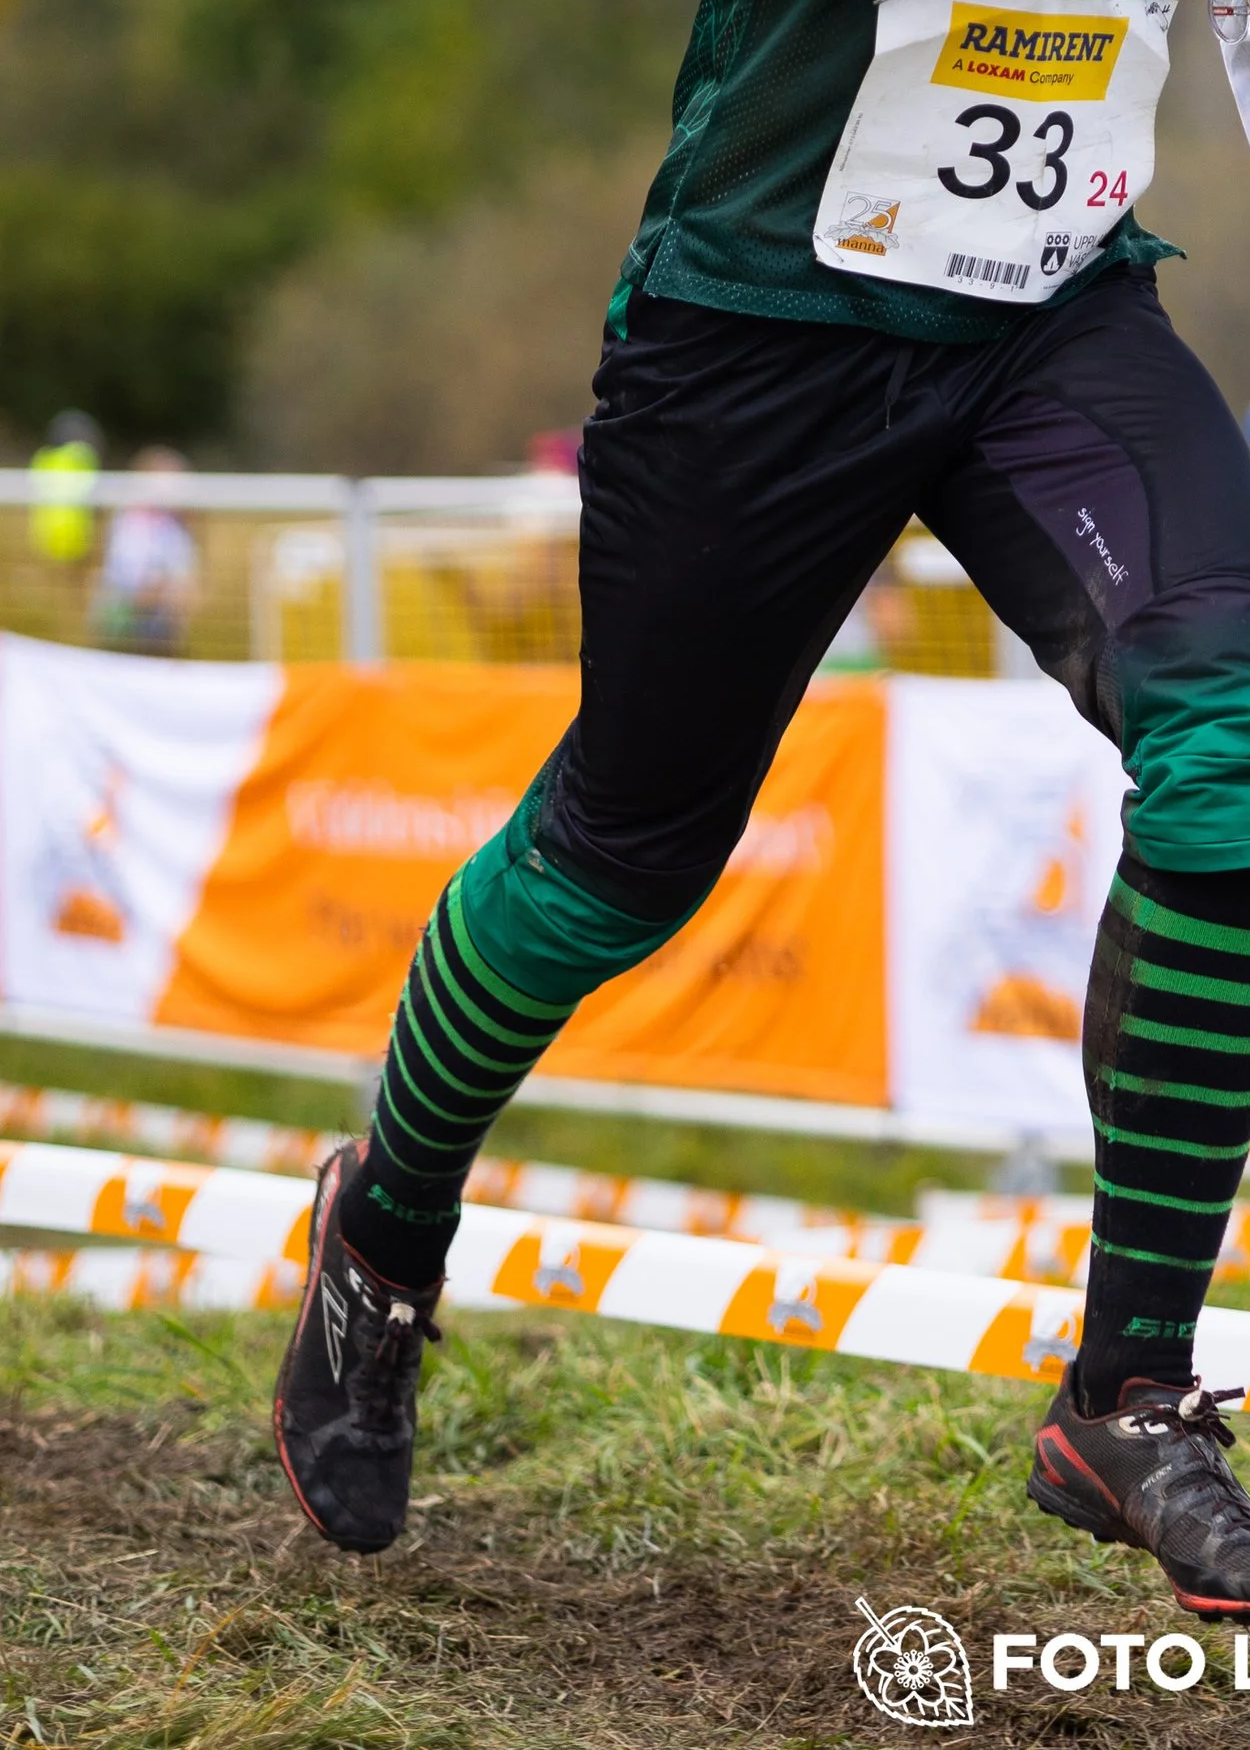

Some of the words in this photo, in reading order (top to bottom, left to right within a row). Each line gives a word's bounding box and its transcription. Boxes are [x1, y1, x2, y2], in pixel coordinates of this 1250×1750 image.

[960, 22, 1115, 62] RAMIRENT
[952, 59, 963, 71] A
[967, 60, 1026, 81] LOXAM
[1029, 71, 1075, 86] Company
[937, 103, 1075, 211] 33
[1086, 169, 1129, 208] 24
[845, 195, 892, 230] 25
[838, 237, 885, 253] manna
[1076, 507, 1096, 536] sign
